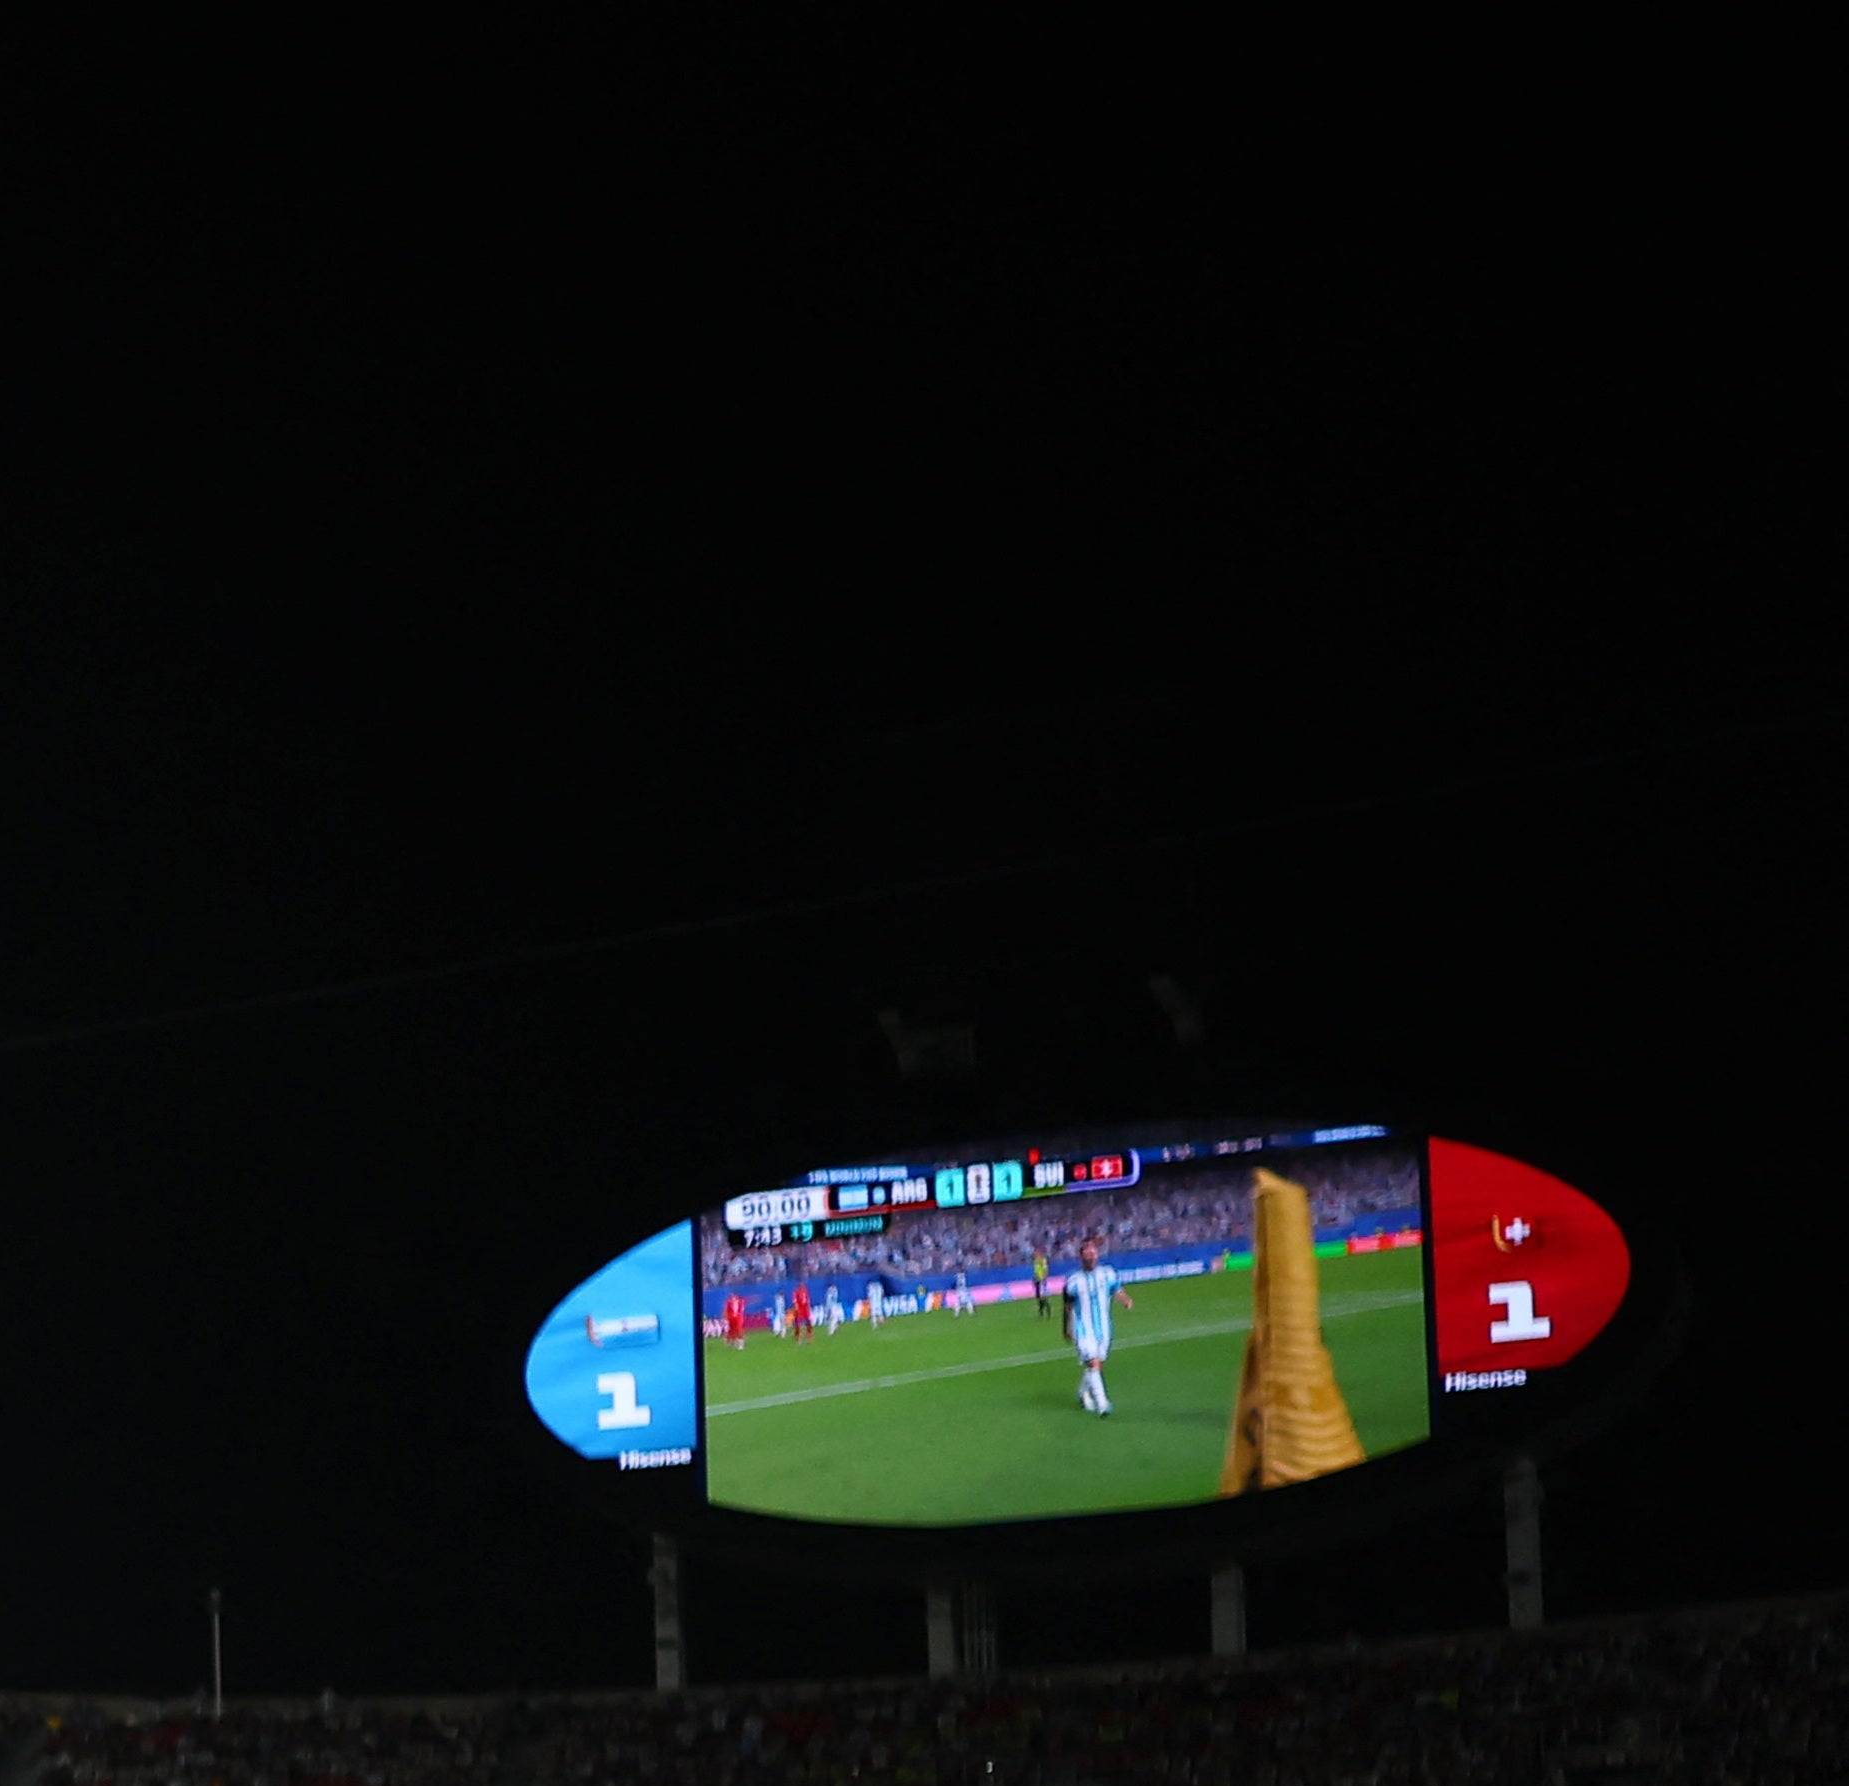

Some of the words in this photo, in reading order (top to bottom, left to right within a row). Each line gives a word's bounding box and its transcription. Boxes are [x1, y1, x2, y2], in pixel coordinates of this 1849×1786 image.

[1489, 1280, 1550, 1343] 1
[597, 1371, 651, 1431] 1
[1445, 1369, 1527, 1392] Hisense
